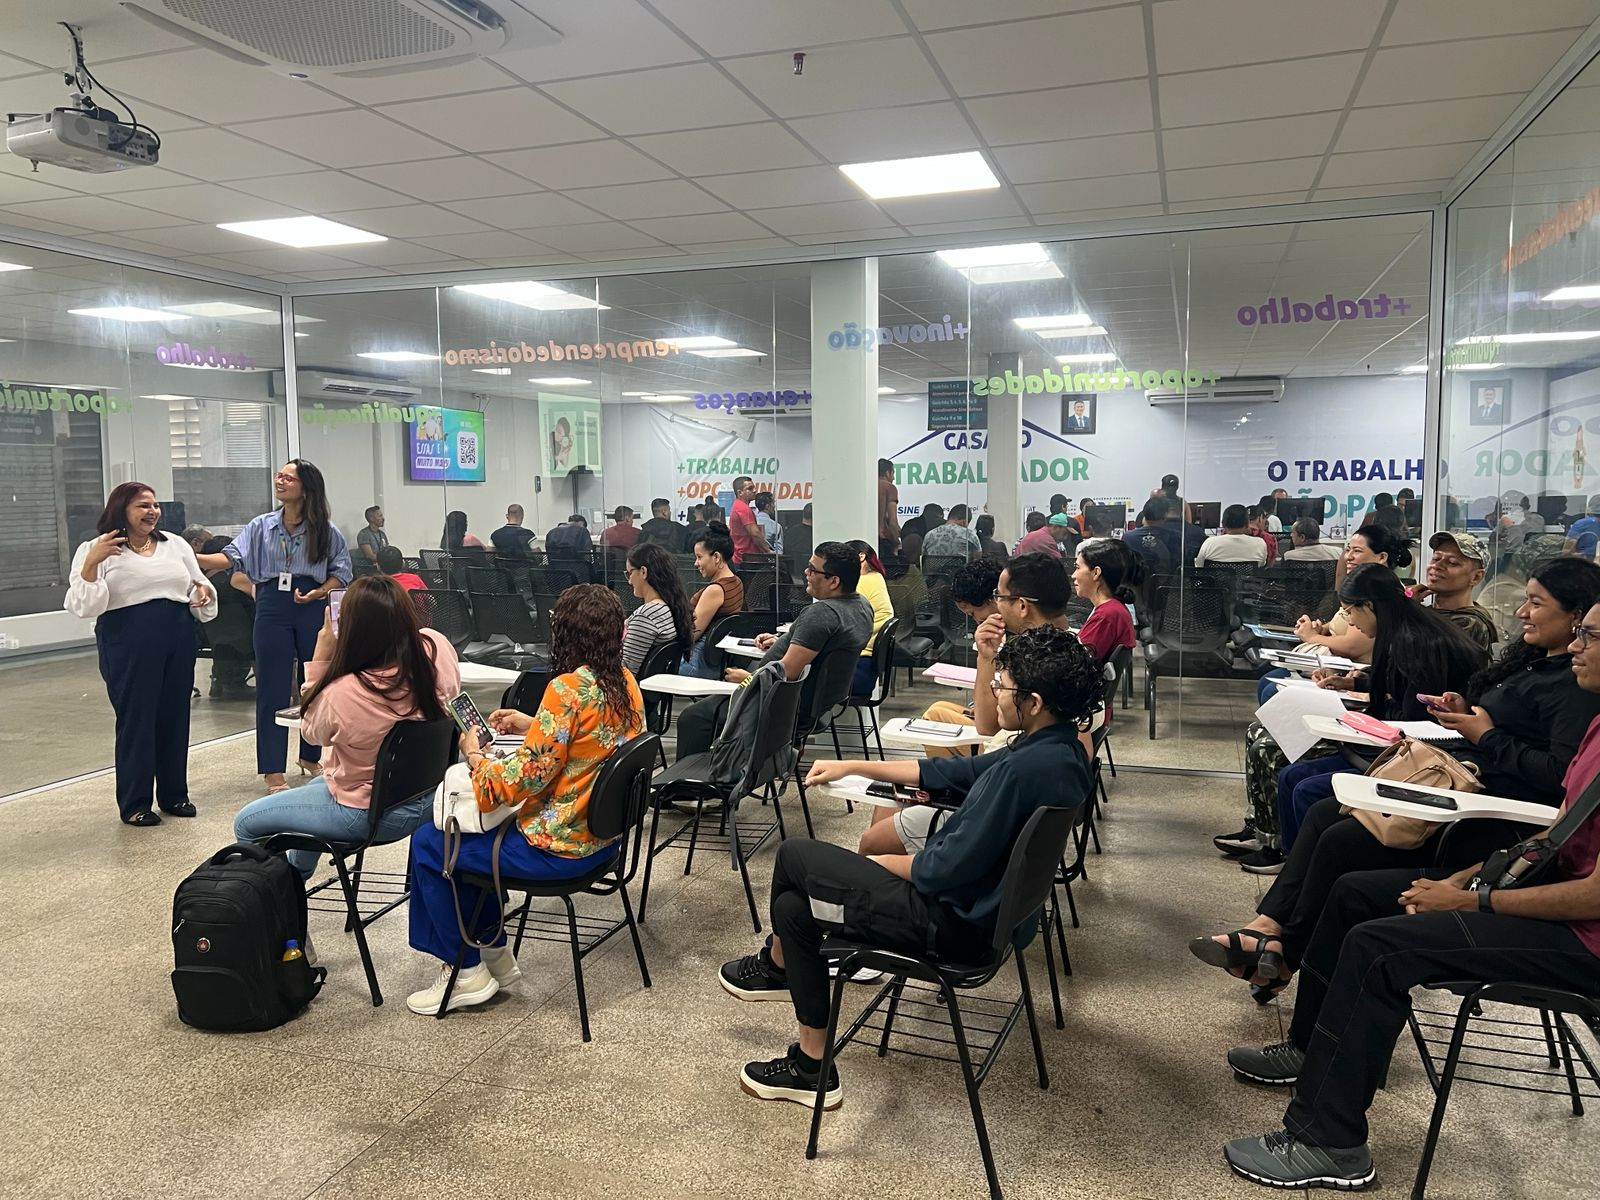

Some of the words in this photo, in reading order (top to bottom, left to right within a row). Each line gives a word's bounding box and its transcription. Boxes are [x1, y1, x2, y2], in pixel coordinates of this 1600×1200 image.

[677, 457, 779, 474] +TRABALHO
[1268, 461, 1288, 482] O
[1295, 459, 1448, 481] TRABALH
[898, 506, 920, 514] SINE
